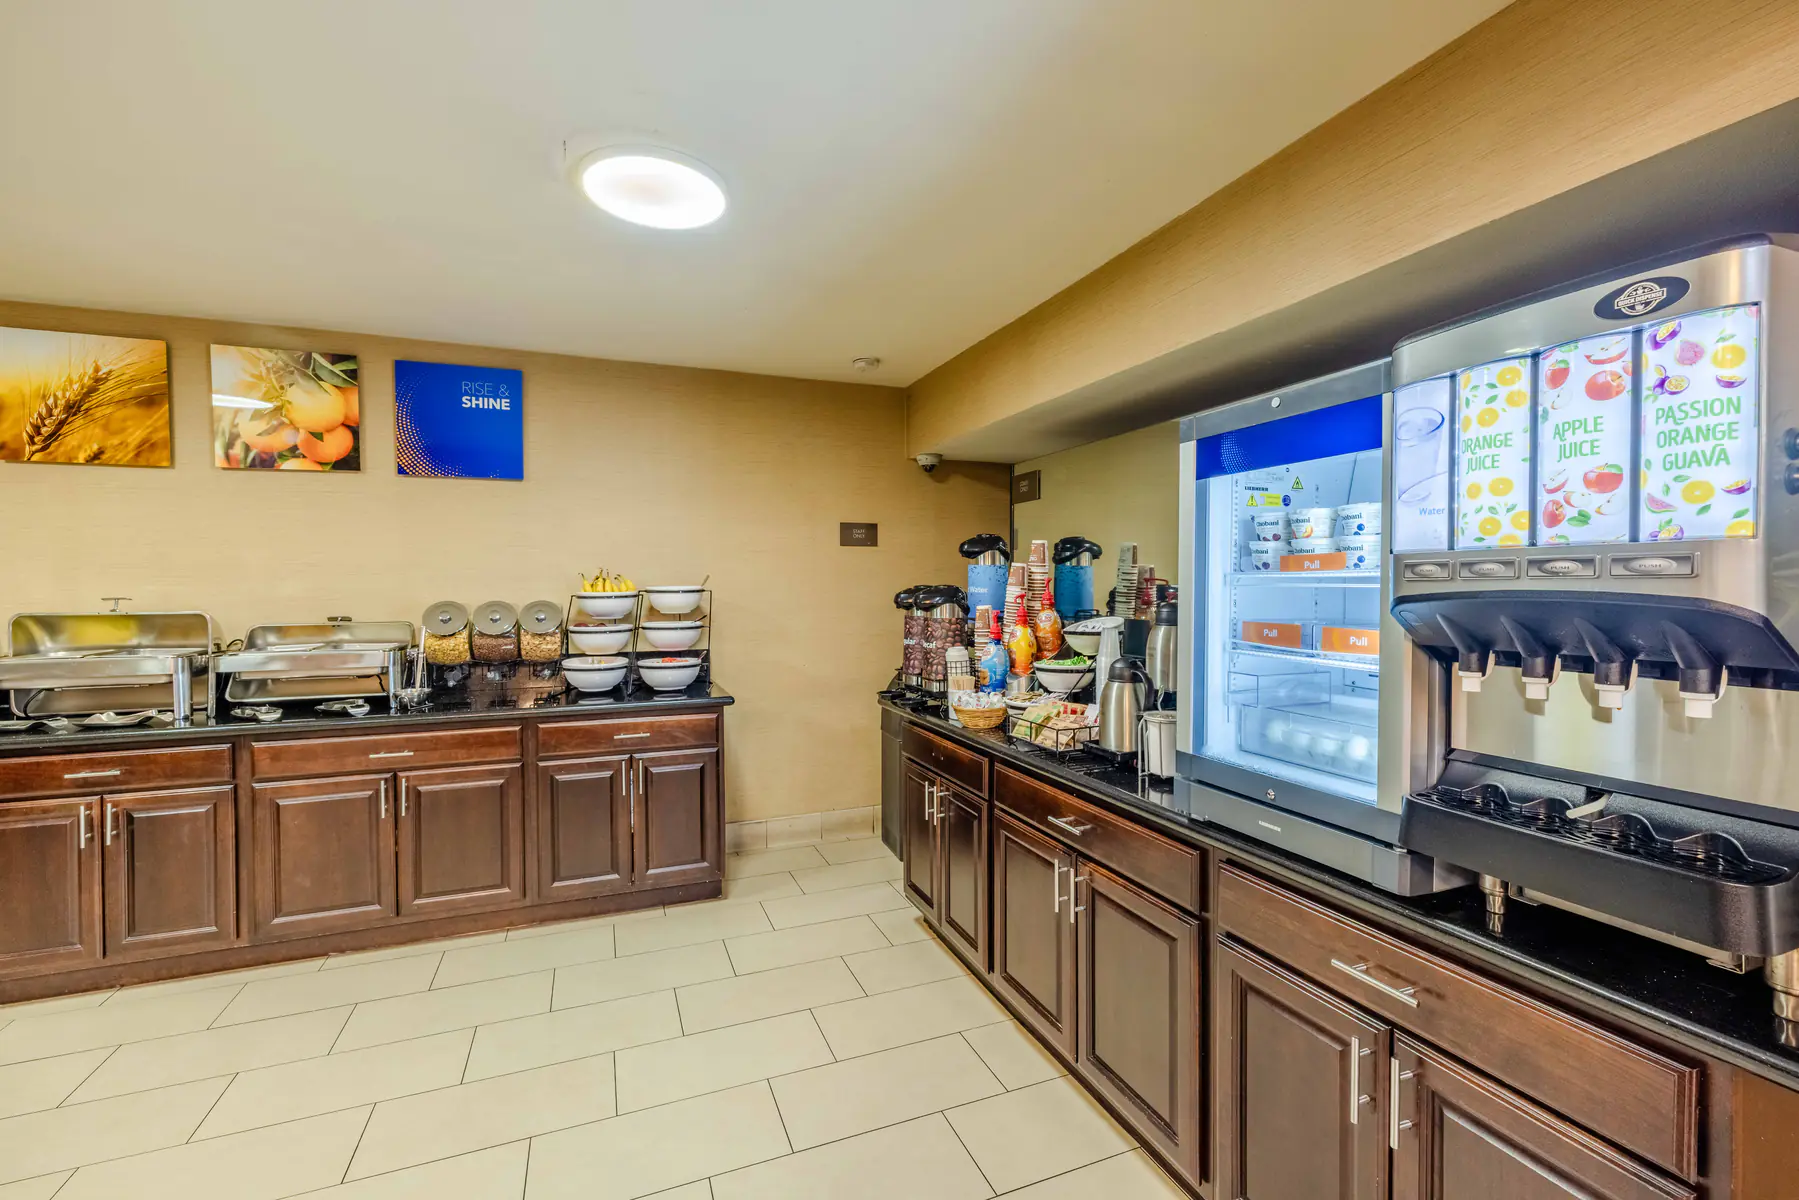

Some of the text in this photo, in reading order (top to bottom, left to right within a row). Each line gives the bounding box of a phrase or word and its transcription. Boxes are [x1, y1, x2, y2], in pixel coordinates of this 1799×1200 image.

[462, 381, 510, 397] RISE &
[461, 396, 511, 411] SHINE
[1655, 396, 1742, 426] PASSION
[1552, 415, 1604, 442] APPLE
[1656, 421, 1740, 449] ORANGE
[1461, 432, 1514, 455] ORANGE
[1557, 438, 1601, 463] JUICE
[1465, 454, 1501, 475] JUICE
[1662, 443, 1731, 472] GUAVA
[1418, 506, 1446, 516] Water
[1303, 560, 1320, 569] Pull
[1263, 628, 1278, 638] Pull
[1349, 636, 1368, 647] Pull
